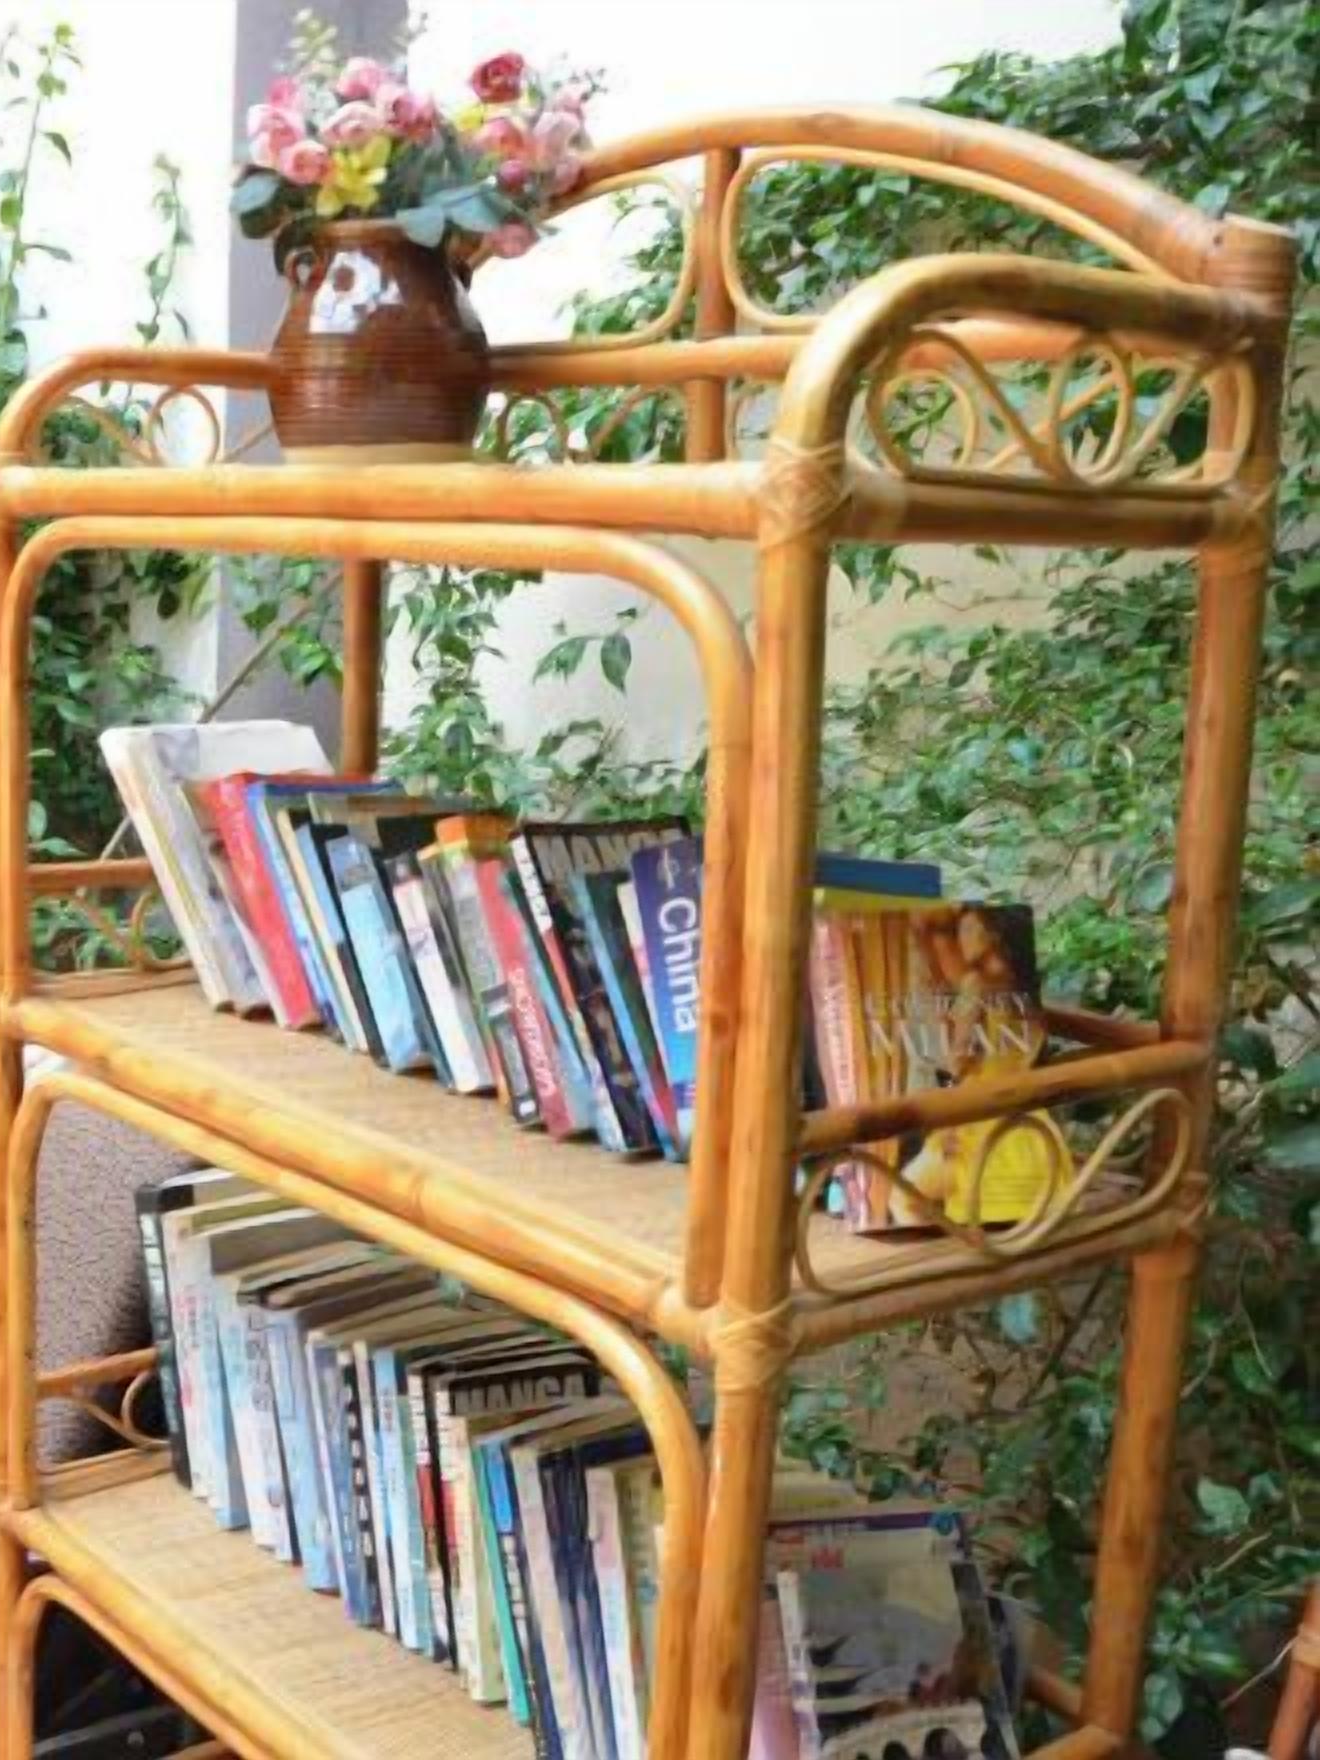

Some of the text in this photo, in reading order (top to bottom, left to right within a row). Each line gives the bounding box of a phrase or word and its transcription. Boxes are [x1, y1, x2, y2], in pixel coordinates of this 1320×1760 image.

[532, 829, 683, 882] MAN
[658, 896, 701, 1033] China
[454, 1372, 586, 1415] MANGA
